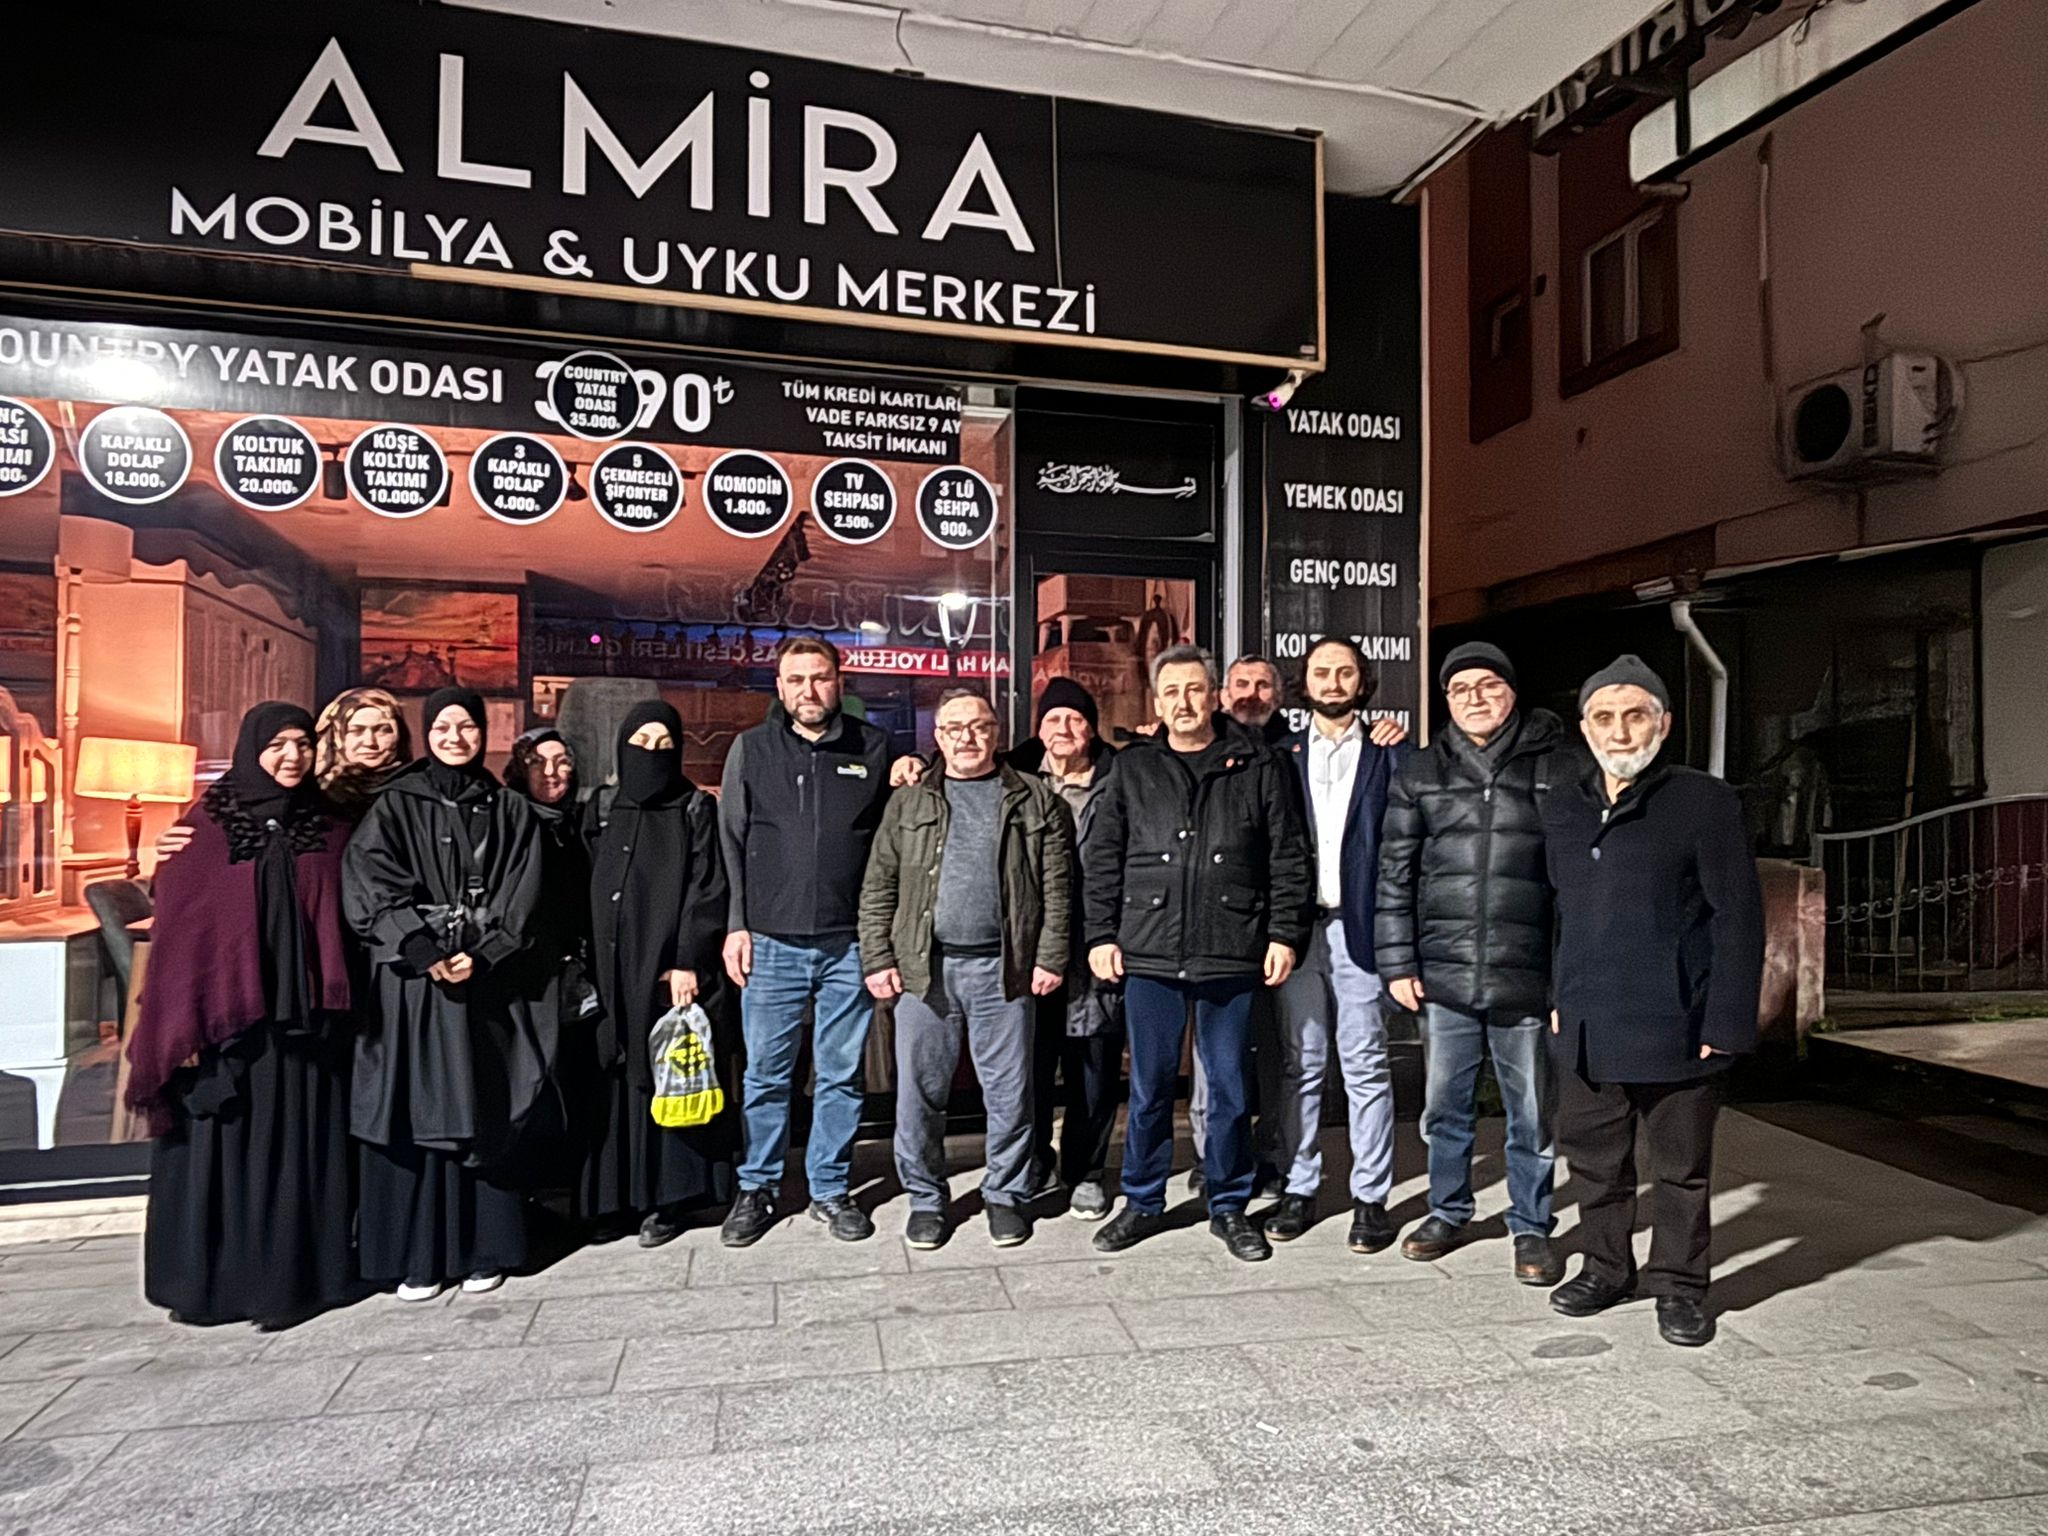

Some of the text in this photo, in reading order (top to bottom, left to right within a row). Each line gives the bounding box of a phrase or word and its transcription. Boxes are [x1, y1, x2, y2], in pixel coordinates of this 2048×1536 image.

[256, 36, 1036, 253] ALMİRA
[170, 186, 1096, 334] MOBİLYA & UYKU MERKEZİ
[210, 345, 358, 392] YATAK
[370, 359, 502, 403] ODASI
[564, 365, 628, 384] COUNTRY
[575, 382, 617, 398] YATAK
[781, 380, 819, 400] TÜM
[824, 385, 876, 405] KREDİ
[575, 397, 616, 413] ODASI
[806, 407, 961, 434] VADE FARKSIZ 9 AY
[1287, 409, 1401, 440] YATAK ODASI
[101, 434, 172, 452] KAPAKLI
[232, 435, 305, 455] KOLTUK
[373, 431, 419, 453] KÖŞE
[514, 444, 526, 459] 3
[823, 431, 947, 456] TAKSİT İMKANI
[108, 452, 165, 469] DOLAP
[234, 455, 302, 475] TAKIMI
[363, 451, 430, 470] KOLTUK
[487, 458, 550, 478] KAPAKLI
[632, 454, 643, 468] 5
[364, 470, 427, 489] TAKIMI
[493, 476, 544, 493] DOLAP
[600, 467, 673, 487] ÇEKMECELİ
[713, 474, 782, 496] KOMODİN
[843, 472, 864, 490] TV
[605, 483, 669, 503] ŞİFONYER
[823, 490, 885, 511] SEHPASI
[1284, 483, 1404, 513] YEMEK ODASI
[934, 499, 979, 518] SEHPA
[1290, 559, 1397, 590] GENÇ ODASI
